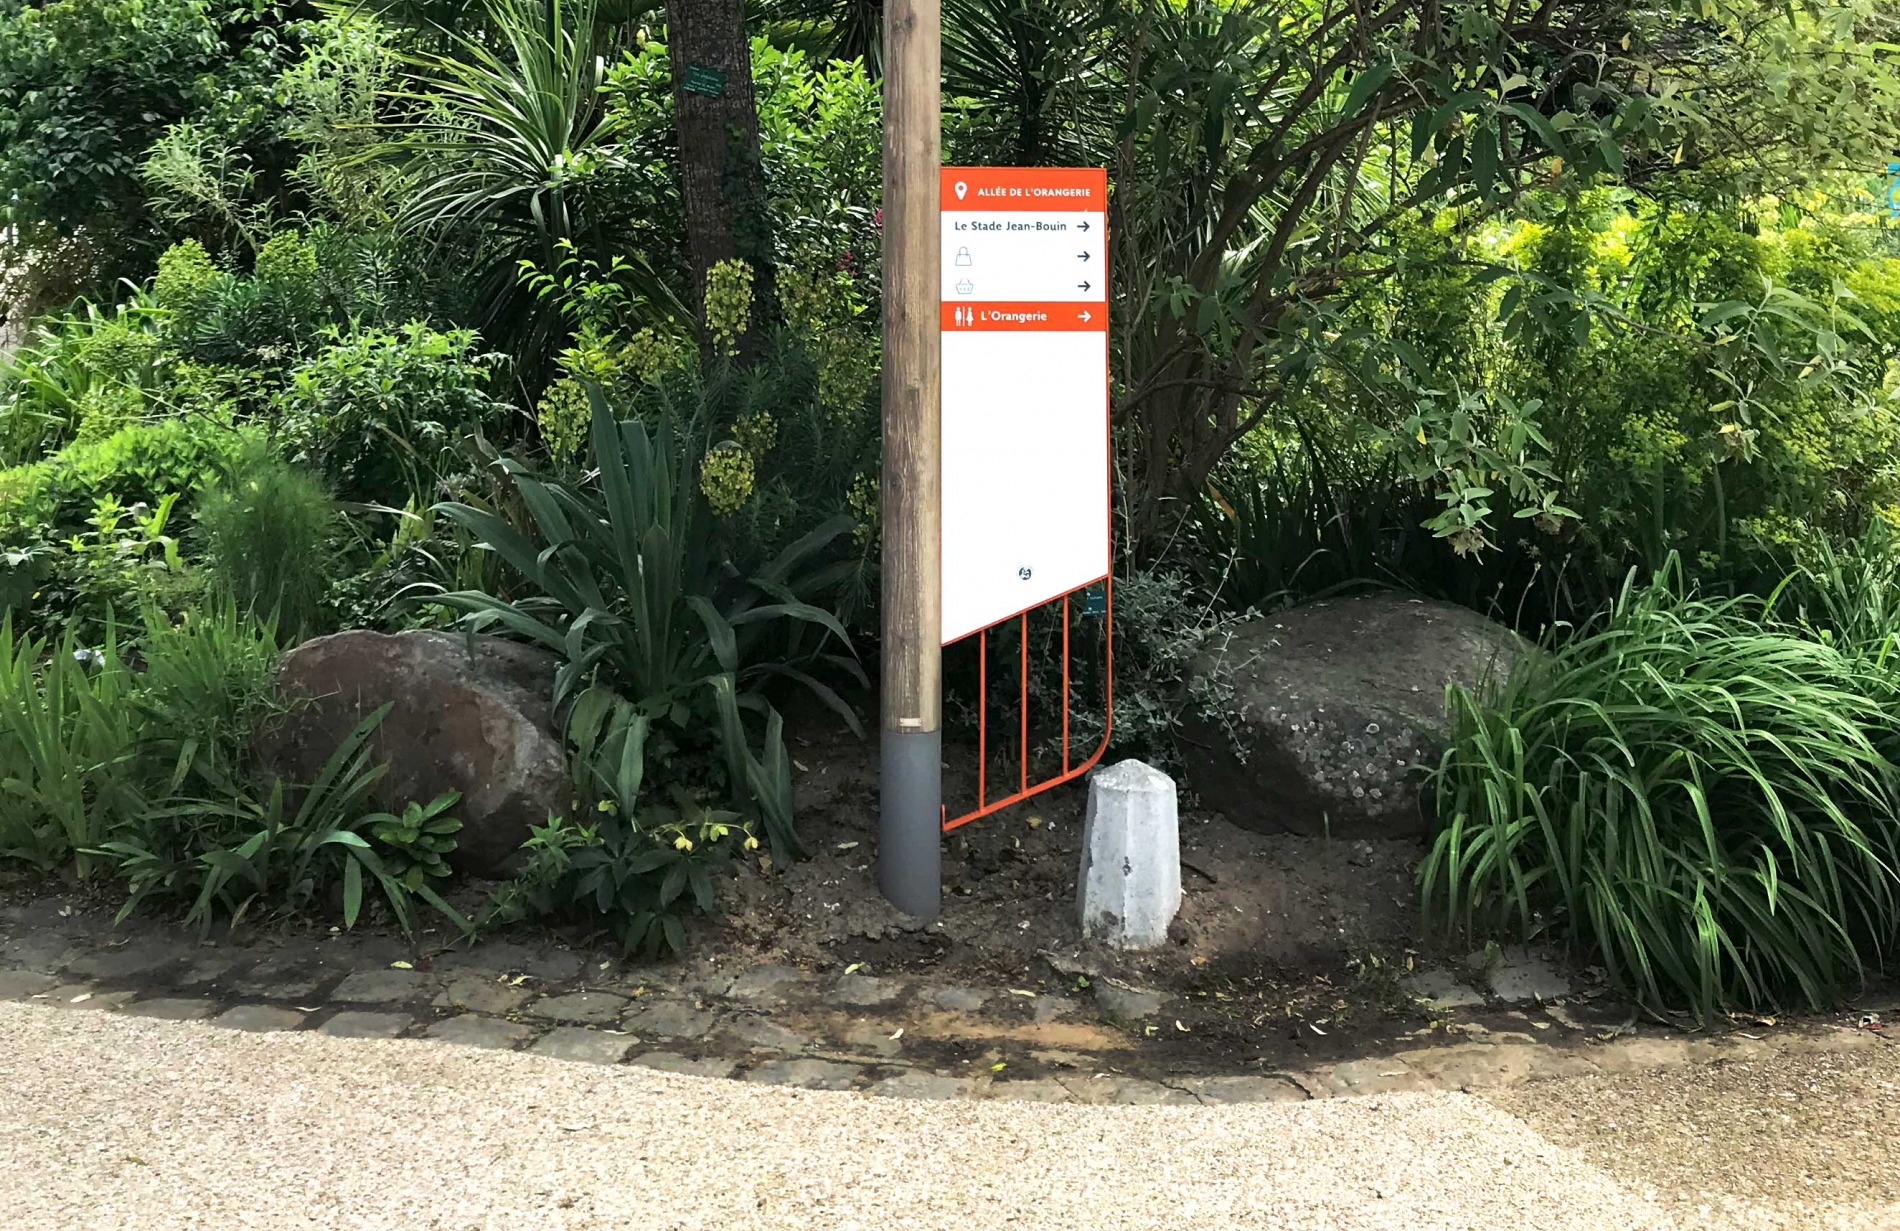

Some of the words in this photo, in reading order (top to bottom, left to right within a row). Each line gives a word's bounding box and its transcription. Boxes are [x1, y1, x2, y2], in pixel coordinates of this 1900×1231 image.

[977, 185, 1007, 197] ALLÉE
[1009, 187, 1023, 197] DE
[1024, 187, 1091, 197] L'ORANGERIE
[954, 221, 968, 231] Le
[971, 221, 1003, 231] Stade
[1006, 221, 1067, 231] Jean-Bouin
[980, 310, 1048, 324] L'Orangerie
